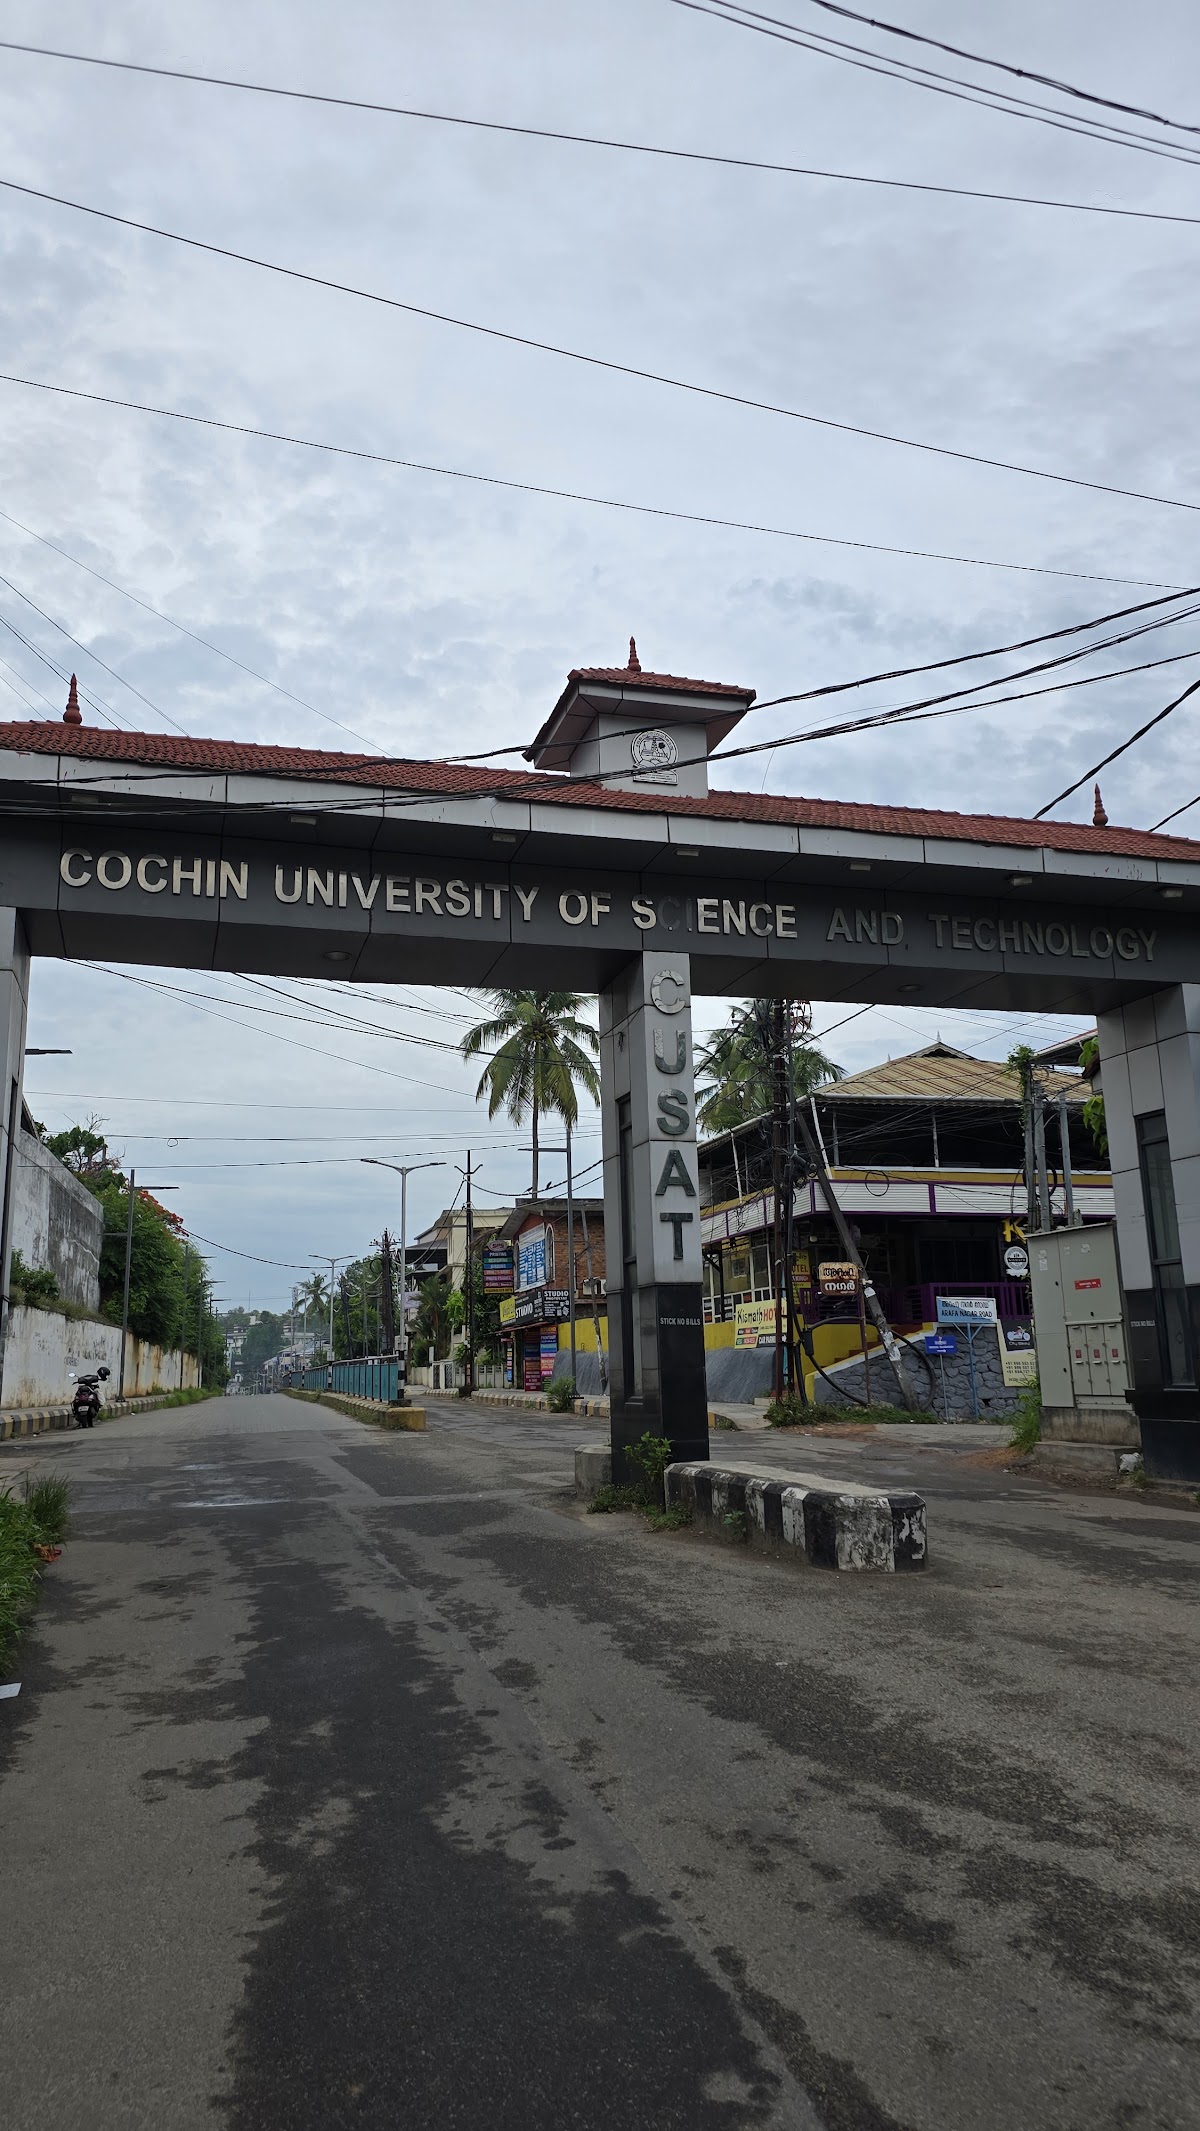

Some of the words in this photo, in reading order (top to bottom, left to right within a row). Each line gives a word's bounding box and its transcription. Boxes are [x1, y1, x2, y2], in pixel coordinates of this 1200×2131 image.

[60, 847, 249, 900] COCHIN
[274, 863, 539, 922] UNIVERSITY
[558, 888, 612, 927] OF
[826, 906, 904, 946] AND
[928, 913, 1158, 962] TECHNOLOGY
[651, 969, 697, 1260] CUSAT
[515, 1303, 534, 1319] STUDIO
[941, 1309, 959, 1317] ARAFA
[660, 1316, 677, 1326] STICK
[677, 1317, 685, 1326] NO
[686, 1317, 701, 1326] BILLS
